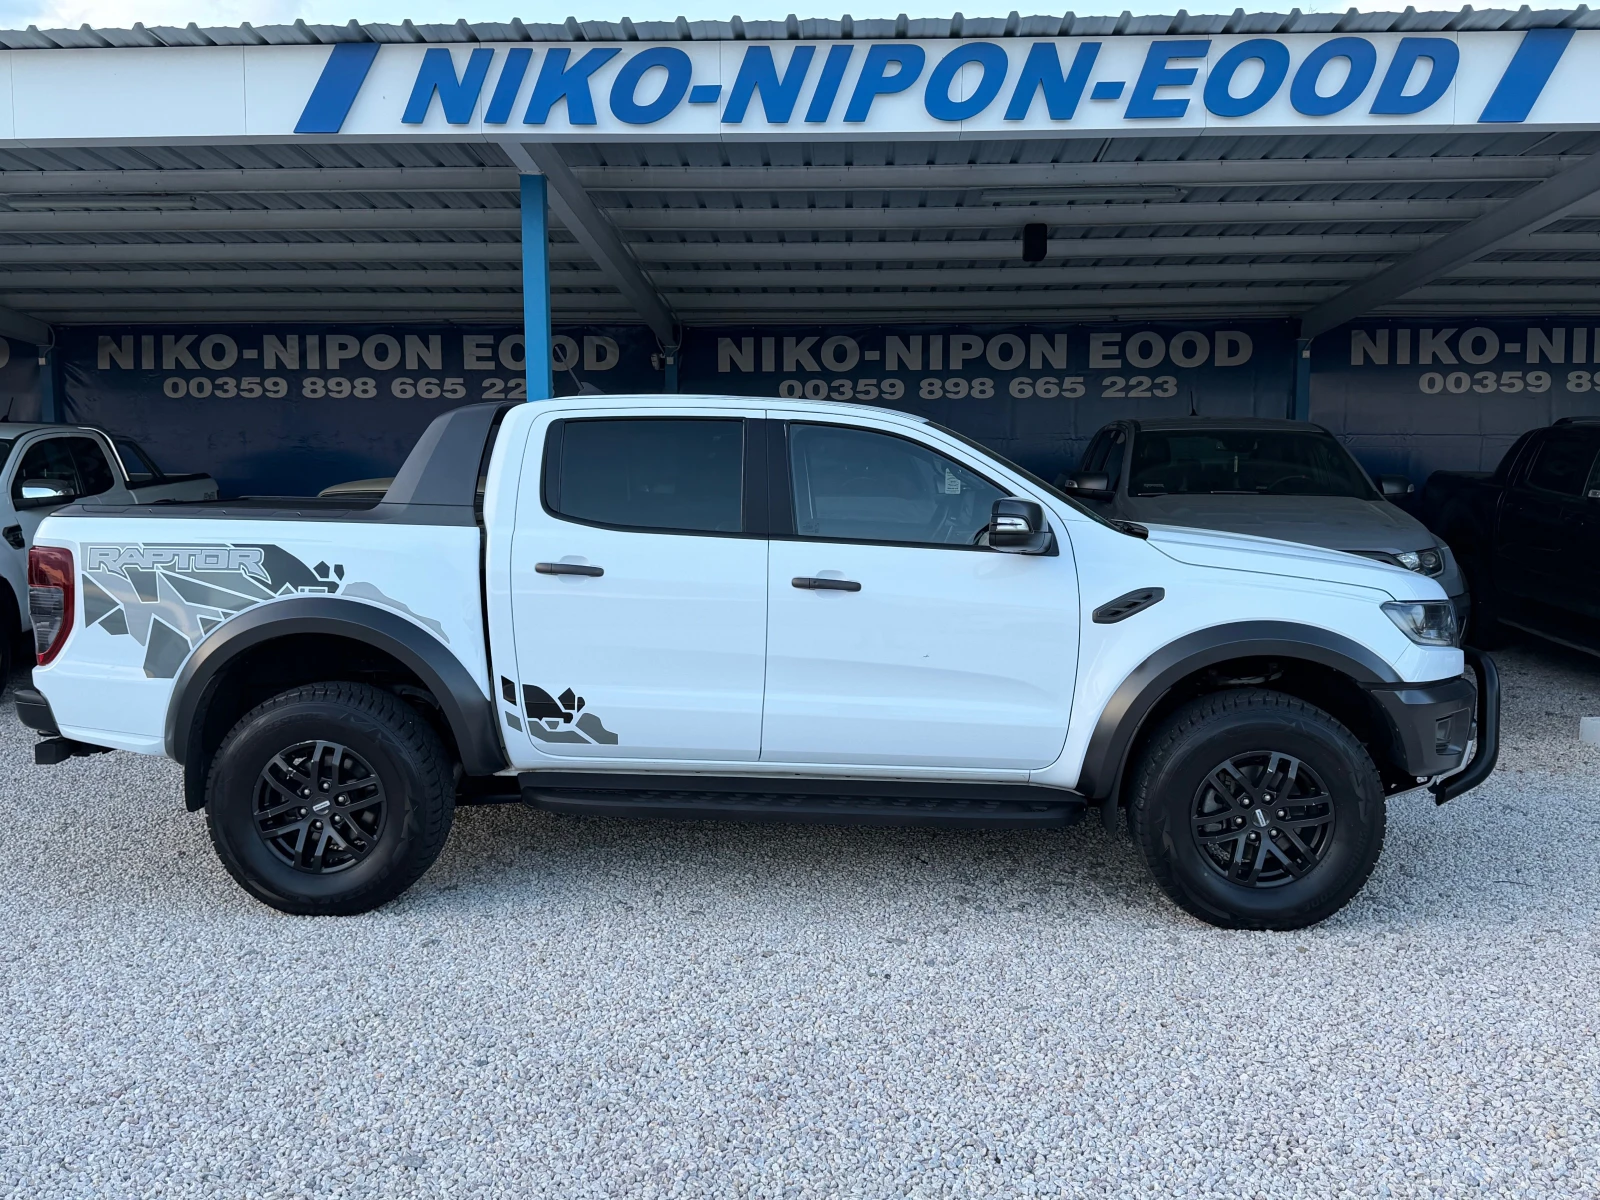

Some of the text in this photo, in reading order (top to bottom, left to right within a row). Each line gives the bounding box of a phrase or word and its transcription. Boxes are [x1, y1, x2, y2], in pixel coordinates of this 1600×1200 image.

[401, 36, 1460, 126] NIKO-NIPON-EOOD
[97, 334, 442, 370] NIKO-NIPON
[718, 330, 1253, 372] NIKO-NIPON EOOD
[1351, 327, 1600, 366] NIKO-NI
[163, 376, 288, 399] 00359
[302, 377, 377, 399] 898
[391, 377, 466, 399] 665
[778, 375, 1178, 400] 00359 898 665 223
[1418, 370, 1600, 394] 00359 8
[87, 547, 271, 584] RAPTOR
